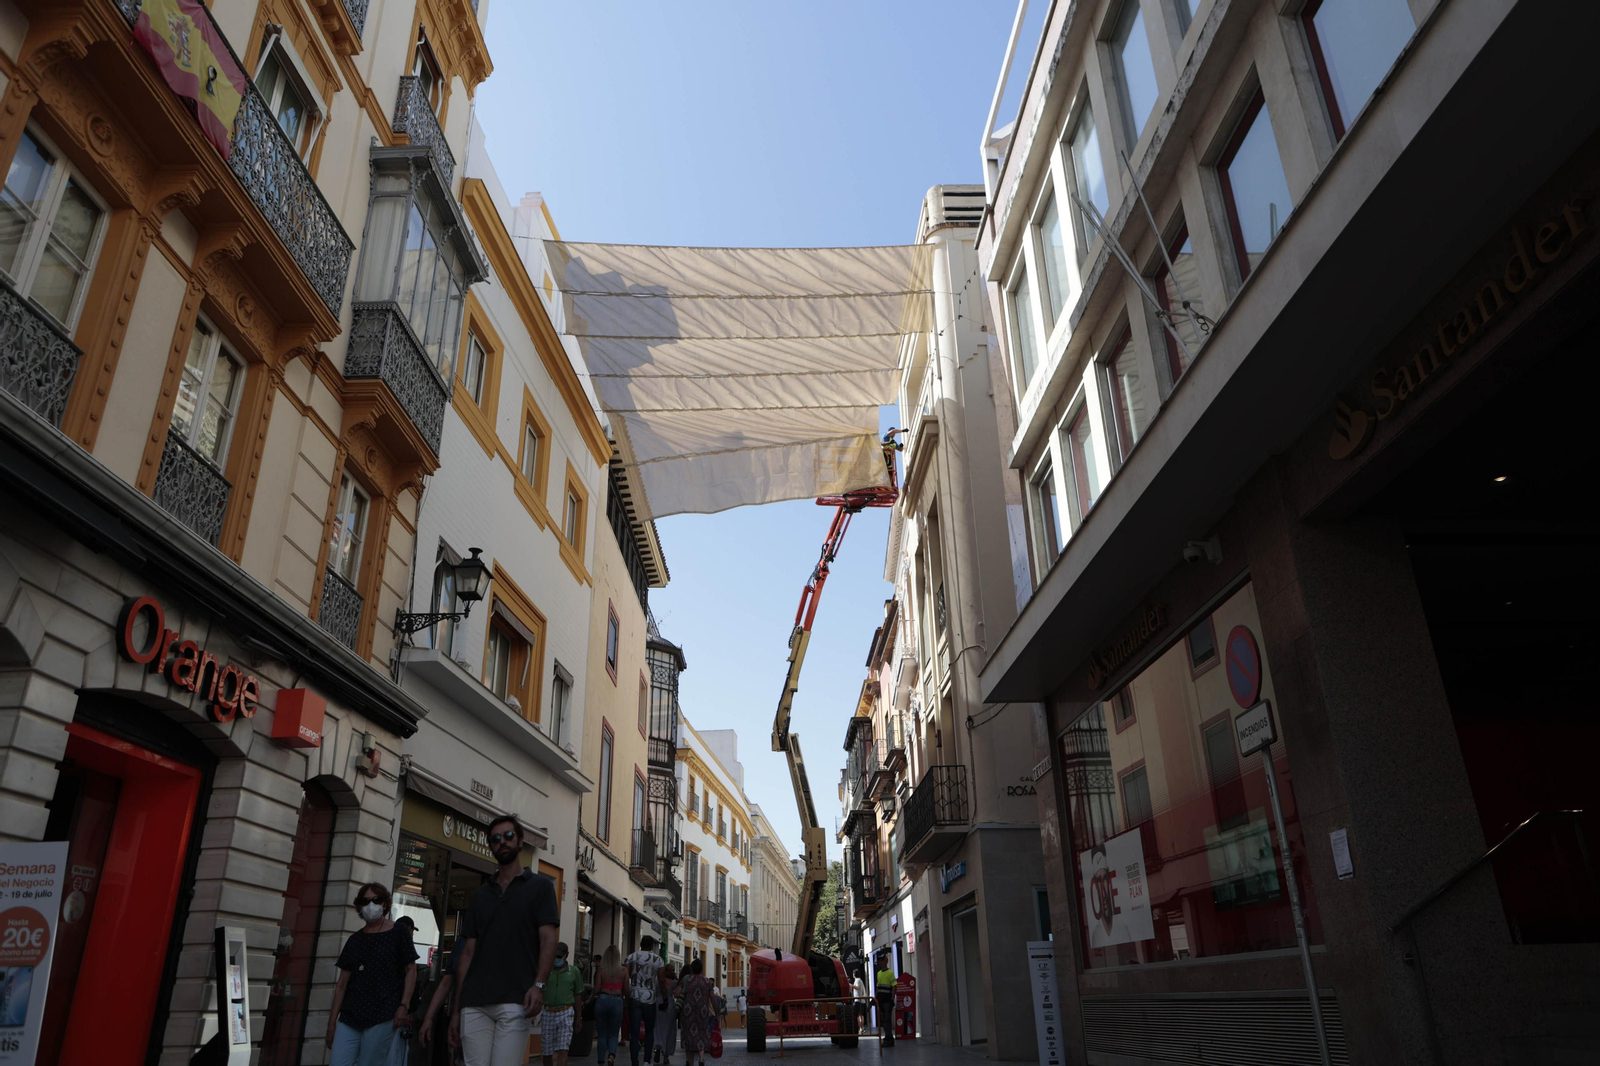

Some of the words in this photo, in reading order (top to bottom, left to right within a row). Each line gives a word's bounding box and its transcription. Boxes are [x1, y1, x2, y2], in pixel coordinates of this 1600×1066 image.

[1371, 196, 1592, 420] Santander
[1101, 604, 1163, 676] Santander
[117, 596, 259, 723] Orange
[300, 725, 320, 742] orange
[1239, 716, 1268, 739] INCENDIOS
[1007, 785, 1037, 797] ROSA
[456, 820, 477, 842] YVES
[471, 843, 493, 858] FRANCE
[0, 862, 56, 876] Semana
[12, 879, 54, 889] Negocio
[22, 890, 33, 898] de
[34, 890, 52, 900] julio
[2, 927, 44, 948] 20€
[786, 1024, 820, 1032] mateco
[0, 1037, 20, 1052] tis
